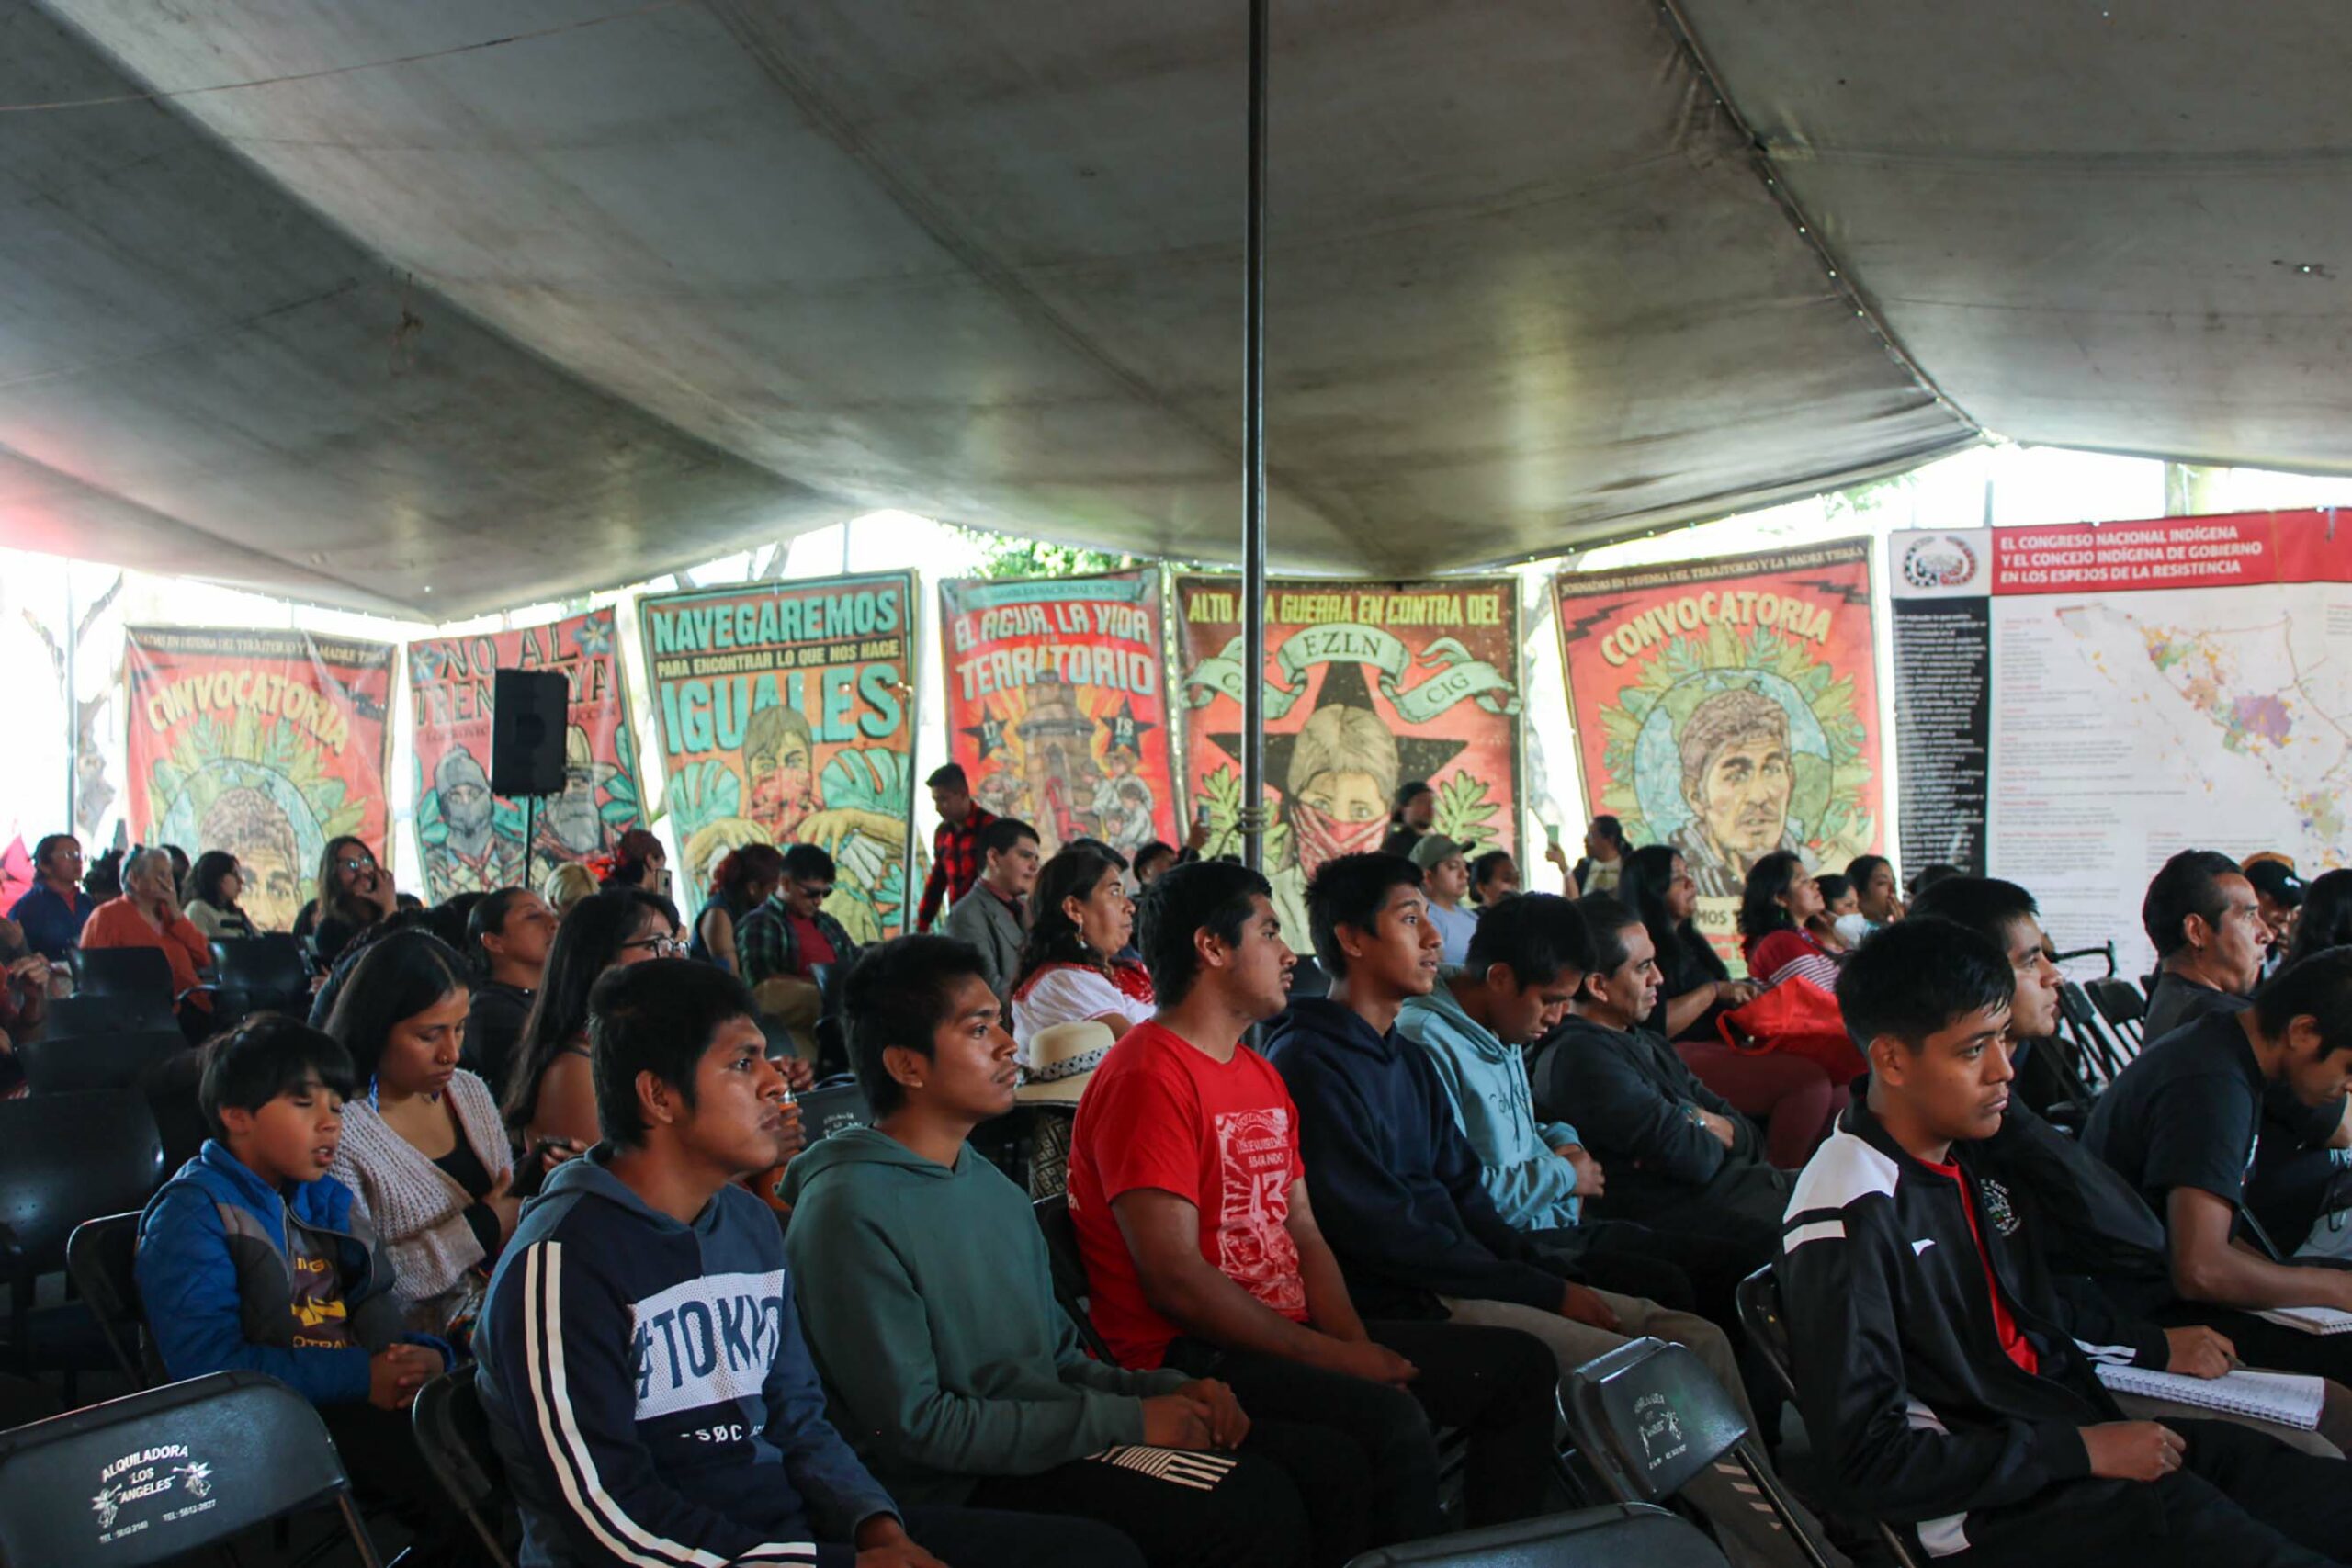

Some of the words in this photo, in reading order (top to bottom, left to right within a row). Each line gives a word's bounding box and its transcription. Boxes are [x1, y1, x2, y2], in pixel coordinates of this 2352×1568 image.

[2001, 536, 2015, 549] EL
[2018, 533, 2093, 548] CONGRESO
[2096, 530, 2166, 547] NACIONAL
[2169, 525, 2238, 543] INDÍGENA
[2001, 555, 2010, 567] Y
[2013, 554, 2029, 567] EL
[2031, 551, 2094, 566] CONCEJO
[2167, 547, 2186, 560] DE
[2188, 541, 2262, 558] GOBIERNO
[2001, 571, 2018, 583] EN
[2021, 570, 2047, 583] LOS
[2050, 567, 2109, 583] ESPEJOS
[2111, 567, 2129, 580] DE
[2132, 565, 2150, 579] LA
[2153, 559, 2242, 578] RESISTENCIA
[651, 589, 899, 655] NAVEGAREMOS
[1189, 593, 1233, 624] ALTO
[1280, 592, 1353, 624] GUERRA
[1358, 594, 1383, 624] EN
[1386, 594, 1464, 625] CONTRA
[1466, 594, 1501, 625] DEL
[955, 617, 978, 653] EL
[1055, 604, 1091, 634] LA
[1092, 603, 1151, 644] VIDA
[1302, 630, 1382, 659] EZLN
[1601, 590, 1833, 667] CONVOCATORIA
[441, 635, 498, 678] NO
[518, 625, 578, 669] AL
[657, 660, 691, 679] PARA
[694, 651, 773, 674] ENCONTRAR
[776, 649, 794, 667] LO
[798, 646, 825, 666] QUE
[830, 643, 857, 661] NOS
[860, 639, 899, 660] HACE
[956, 644, 1156, 702] TERRITORIO
[1425, 671, 1471, 705] CIG
[148, 670, 350, 756] CONVOCATORIA
[413, 678, 495, 727] TREN
[661, 662, 903, 756] IGUALES
[983, 721, 998, 739] 17
[1116, 716, 1134, 736] 18
[102, 1444, 189, 1483] ALQUILADORA
[131, 1467, 154, 1485] LOS
[119, 1476, 173, 1504] ANGELES
